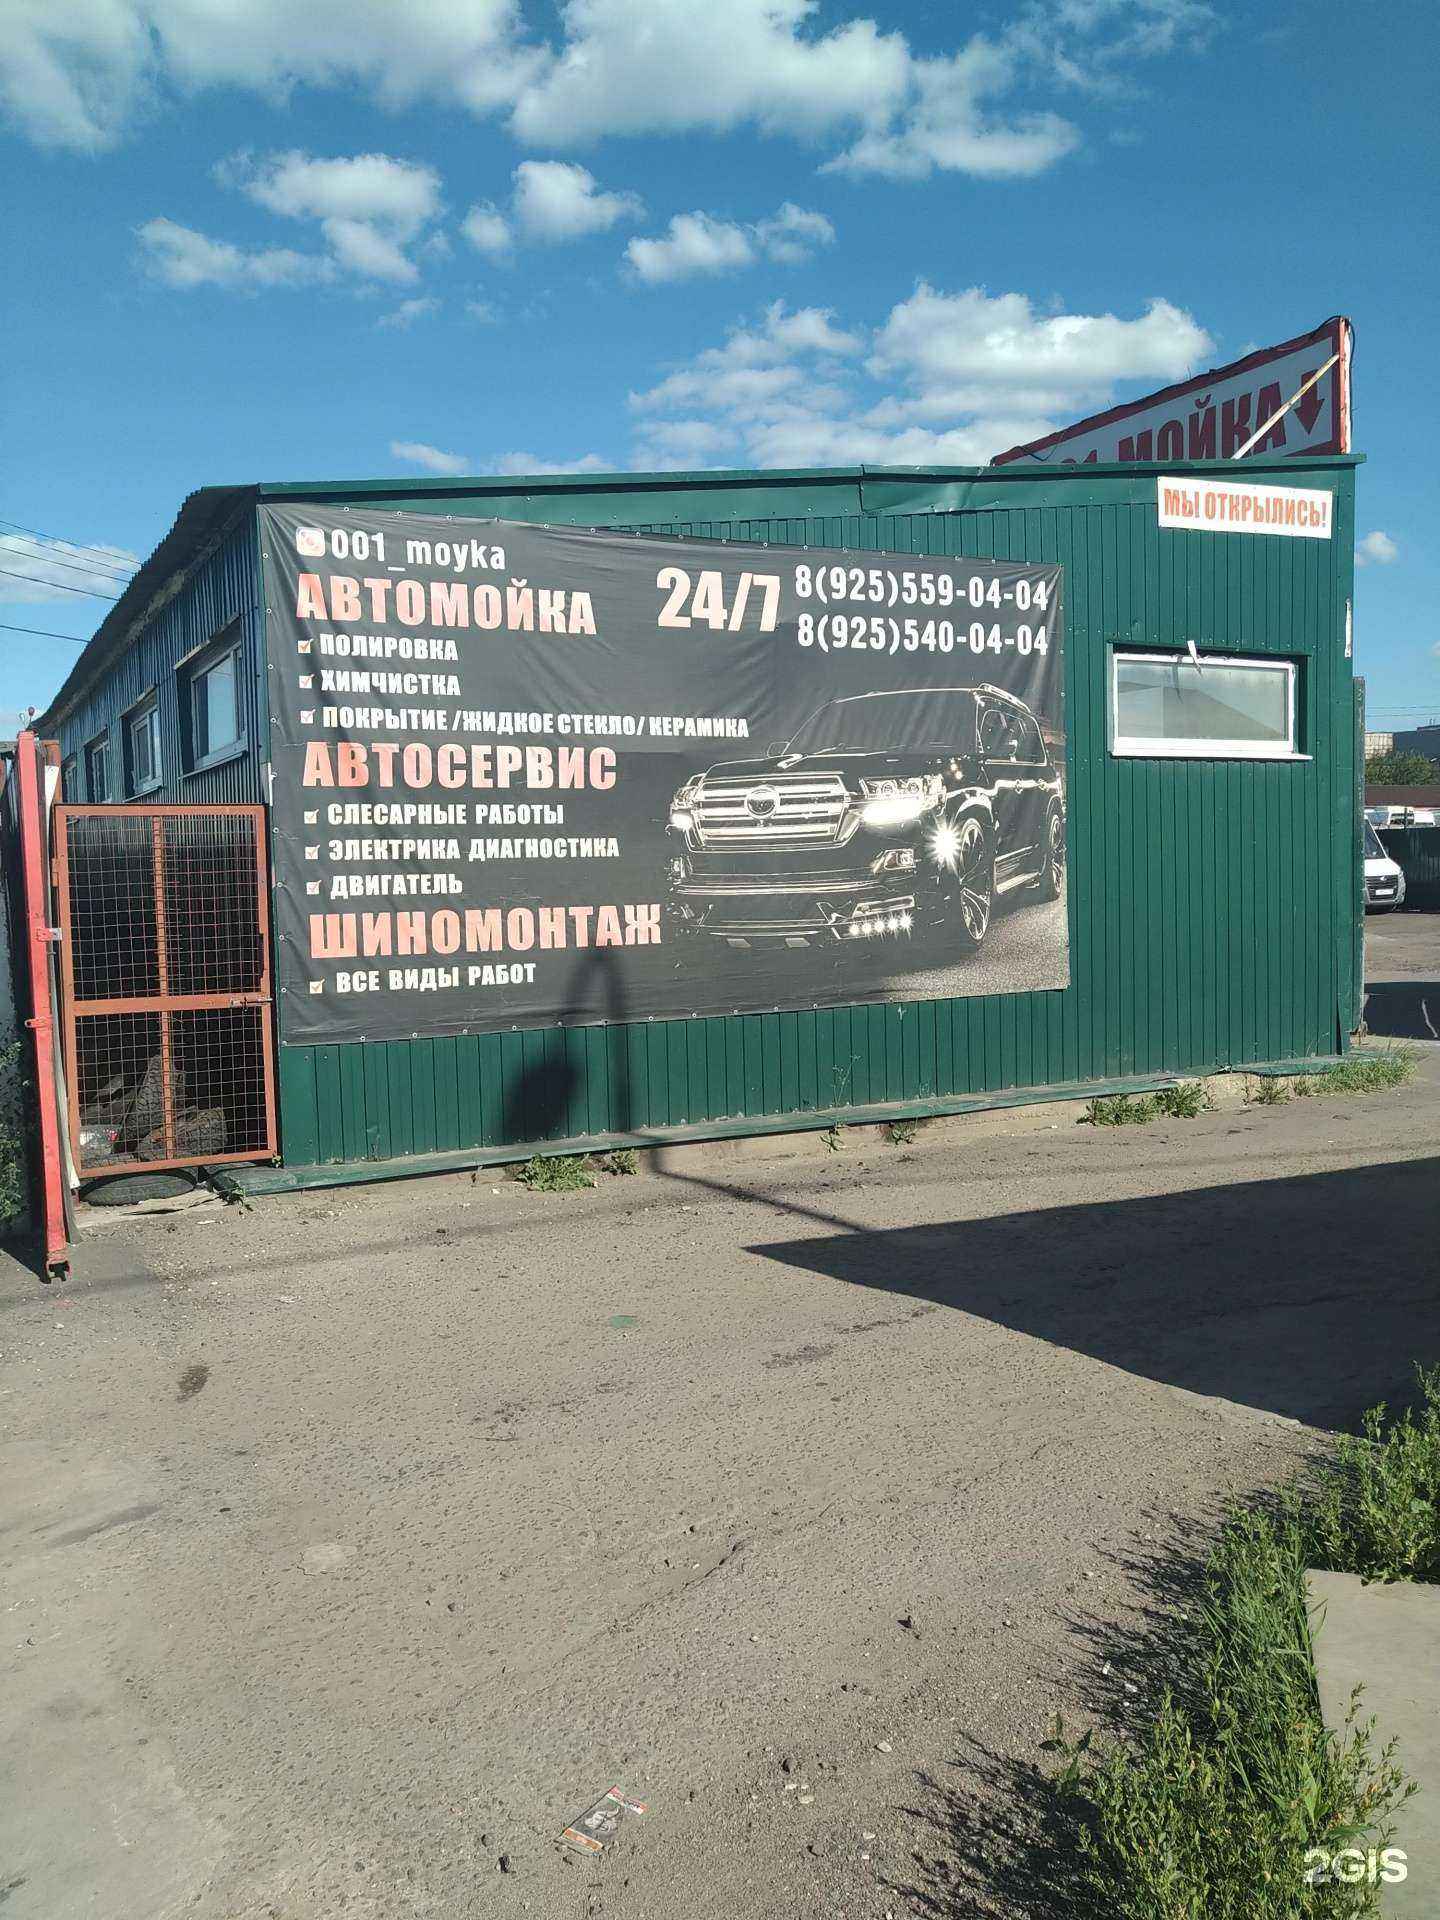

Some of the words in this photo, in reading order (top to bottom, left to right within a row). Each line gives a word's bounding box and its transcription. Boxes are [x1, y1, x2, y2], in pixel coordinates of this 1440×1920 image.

[1118, 380, 1287, 461] МОЙКА
[1164, 488, 1200, 518] МЫ
[1204, 490, 1328, 528] ОТКРЫЛИСЬ!
[331, 528, 506, 572] 001_moyka
[296, 573, 597, 635] АВТОМОЙКА
[656, 567, 782, 632] 24/7
[794, 564, 1049, 611] 8(925)559-04-04
[320, 633, 459, 661] ПОЛИРОВКА
[797, 613, 1049, 655] 8(925)540-04-04
[321, 669, 461, 696] ХИМЧИСТКА
[322, 706, 448, 732] ПОКРЫТИЕ
[302, 741, 618, 791] АВТОСЕРВИС
[327, 803, 467, 825] СЛЕСАРНЫЕ
[475, 803, 564, 825] РАБОТЫ
[329, 838, 461, 861] ЭЛЕКТРИКА
[468, 837, 620, 862] ДИАГНОСТИКА
[330, 873, 463, 900] ДВИГАТЕЛЬ
[309, 903, 663, 959] ШИНОМОНТАЖ
[336, 970, 380, 994] ВСЕ
[389, 965, 460, 992] ВИДЫ
[468, 962, 536, 986] РАБОТ
